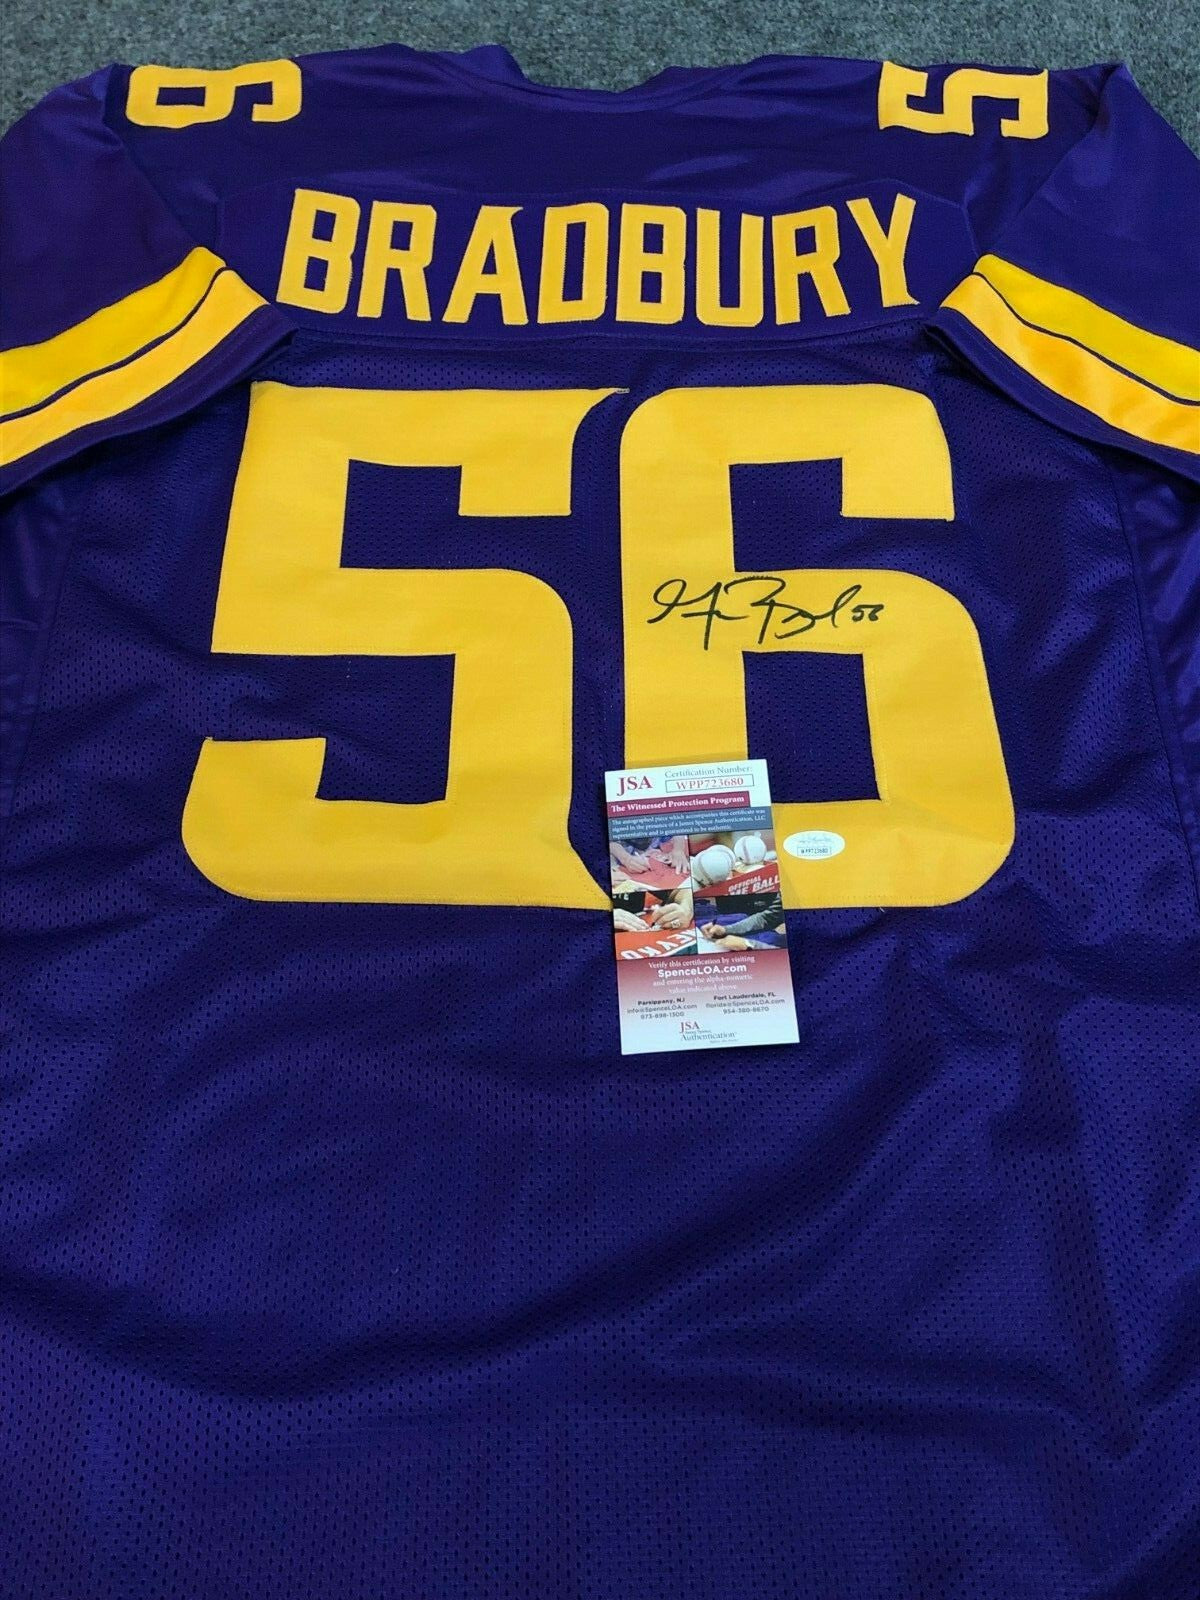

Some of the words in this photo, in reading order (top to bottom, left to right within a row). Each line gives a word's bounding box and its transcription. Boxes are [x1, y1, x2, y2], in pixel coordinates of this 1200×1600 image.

[276, 188, 920, 327] BRADBURY
[851, 603, 884, 622] 56
[181, 382, 1016, 909] 56
[665, 768, 715, 778] Certification
[717, 764, 752, 773] Number:
[616, 775, 653, 796] JSA
[676, 777, 744, 789] WPP723680
[611, 805, 626, 813] The
[627, 800, 667, 811] Witnessed
[668, 798, 709, 808] Protection
[710, 796, 744, 805] Program
[728, 875, 761, 892] OFFICIAL
[752, 875, 780, 892] BALL
[648, 961, 668, 969] Verify
[682, 958, 720, 967] certification
[721, 957, 729, 965] by
[731, 956, 755, 964] visiting
[657, 964, 747, 978] SpenceLOA.com
[679, 1021, 700, 1033] JSA
